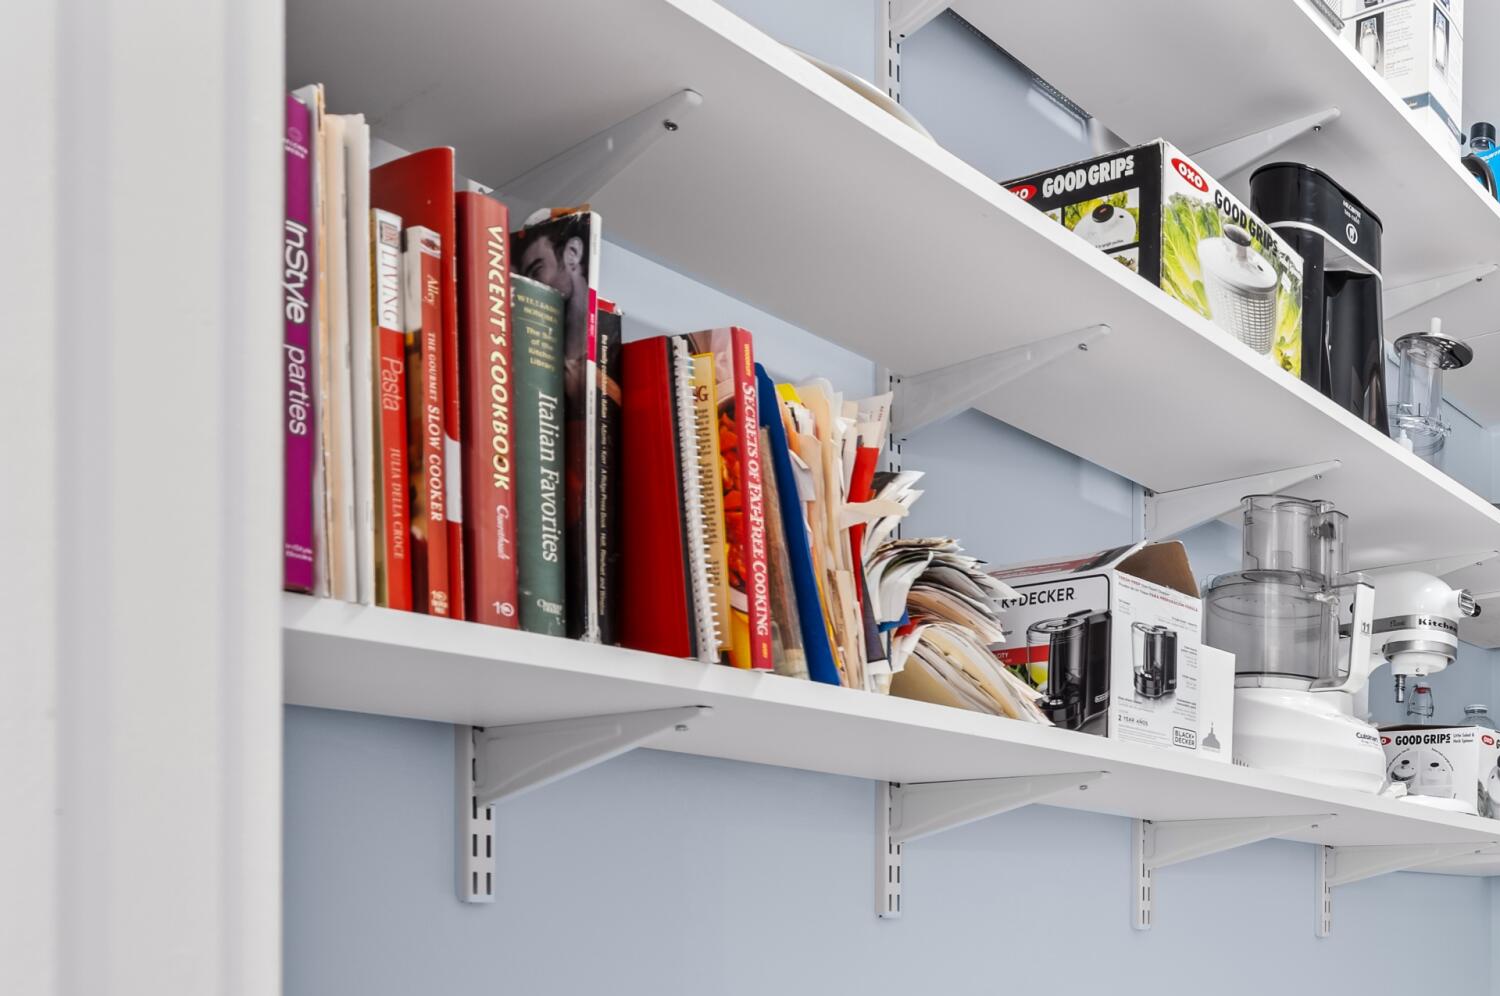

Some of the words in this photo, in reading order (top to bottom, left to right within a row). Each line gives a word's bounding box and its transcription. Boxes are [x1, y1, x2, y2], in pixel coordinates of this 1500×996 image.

[1041, 167, 1086, 199] GOOD
[1088, 154, 1135, 187] GRIPS
[1176, 163, 1204, 189] OXO
[1214, 189, 1248, 230] GOOD
[1248, 218, 1280, 258] GRIPS
[381, 243, 402, 323] LIVING
[422, 273, 440, 307] Alley
[487, 225, 508, 348] VINCENT'S
[427, 332, 436, 351] THE
[288, 344, 311, 436] parties
[382, 357, 404, 413] Pasta
[429, 353, 438, 401] GOURMET
[427, 404, 441, 449] SLOW
[489, 350, 511, 491] COOKBOOK
[538, 391, 558, 460] Italian
[742, 381, 758, 451] SECRETS
[388, 448, 401, 481] JULIA
[429, 453, 443, 521] COOKER
[748, 455, 760, 481] OF
[391, 482, 403, 519] DELLA
[540, 465, 563, 562] Favorites
[748, 481, 764, 556] FAT-FREE
[393, 520, 405, 560] CROCE
[751, 557, 769, 636] COOKING
[1000, 587, 1075, 609] K+DECKER
[1174, 737, 1195, 746] DECKER
[1395, 735, 1422, 746] GOOD
[1423, 733, 1451, 744] GRIPS
